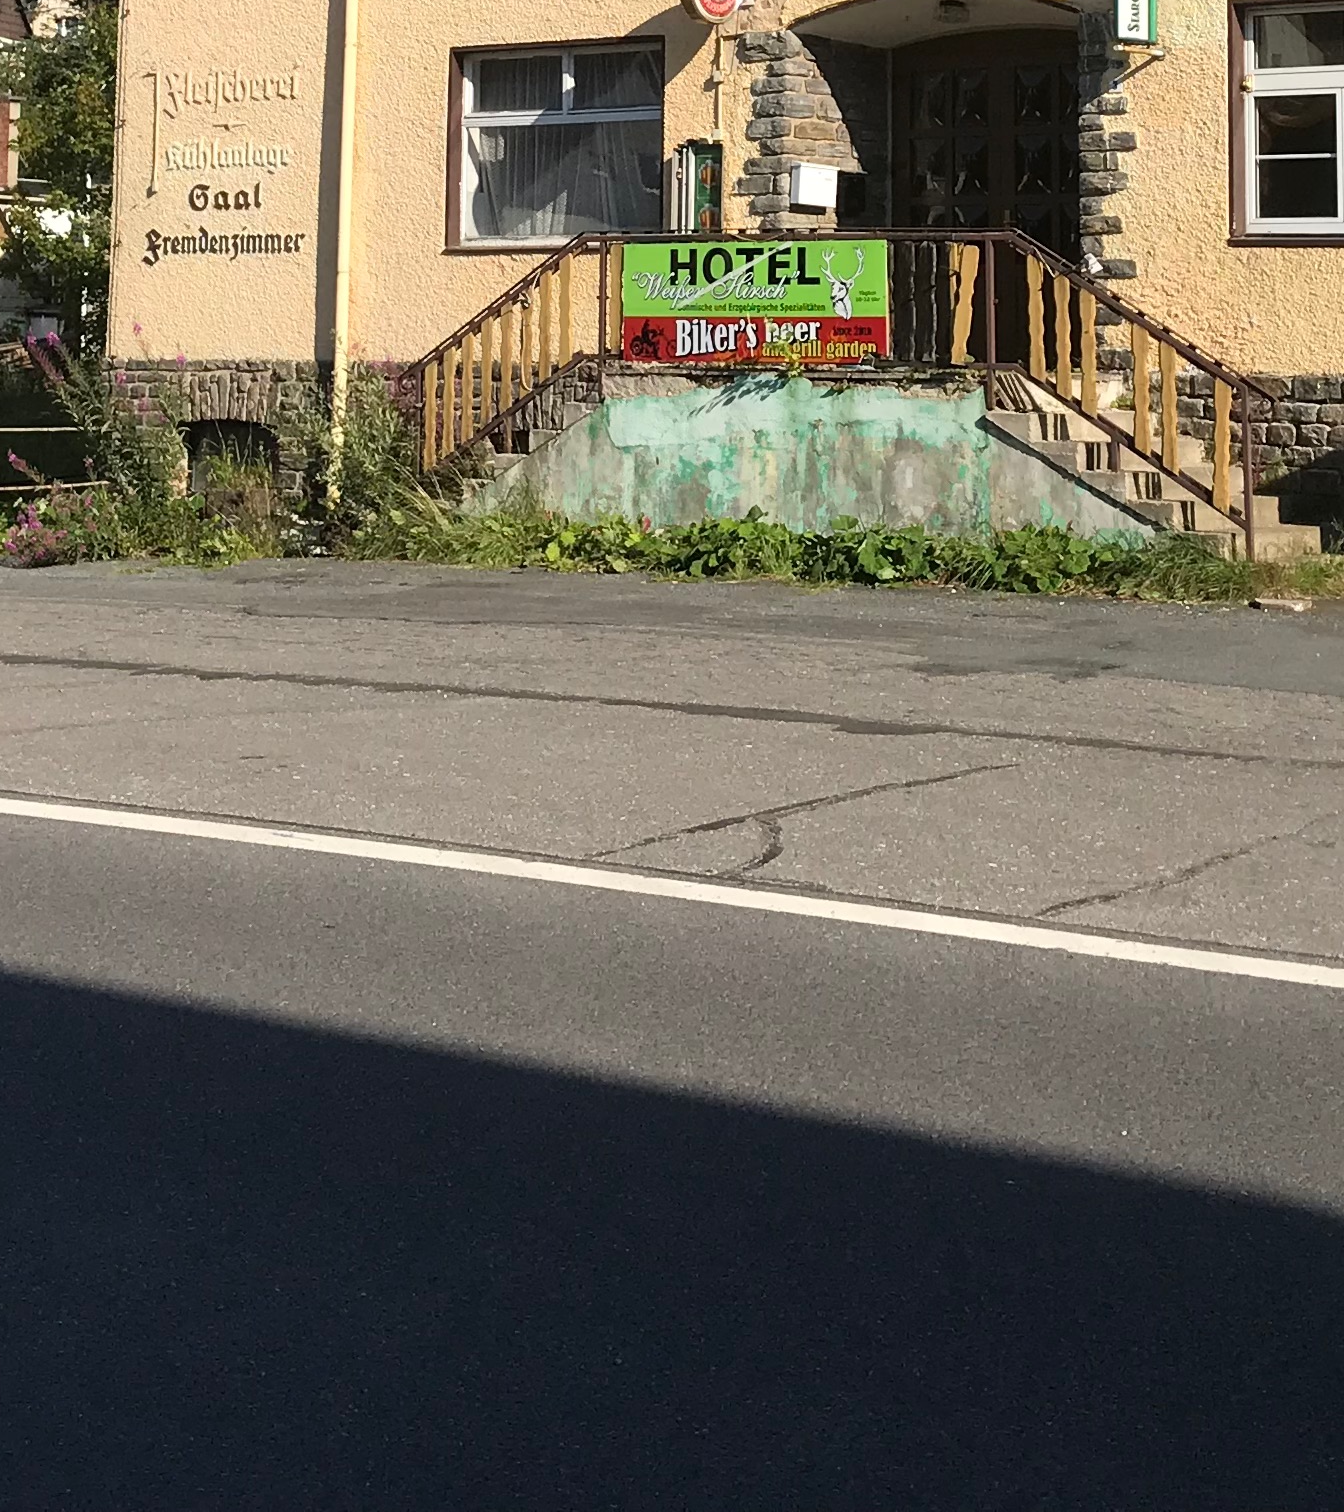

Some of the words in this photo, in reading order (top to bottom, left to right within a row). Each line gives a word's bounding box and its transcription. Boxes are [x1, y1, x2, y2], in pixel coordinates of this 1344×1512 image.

[165, 139, 290, 175] Kühlanlage
[188, 181, 262, 211] Saal
[142, 225, 305, 266] Fremdenzimmer
[670, 247, 821, 285] HOTEL
[826, 340, 877, 359] garden
